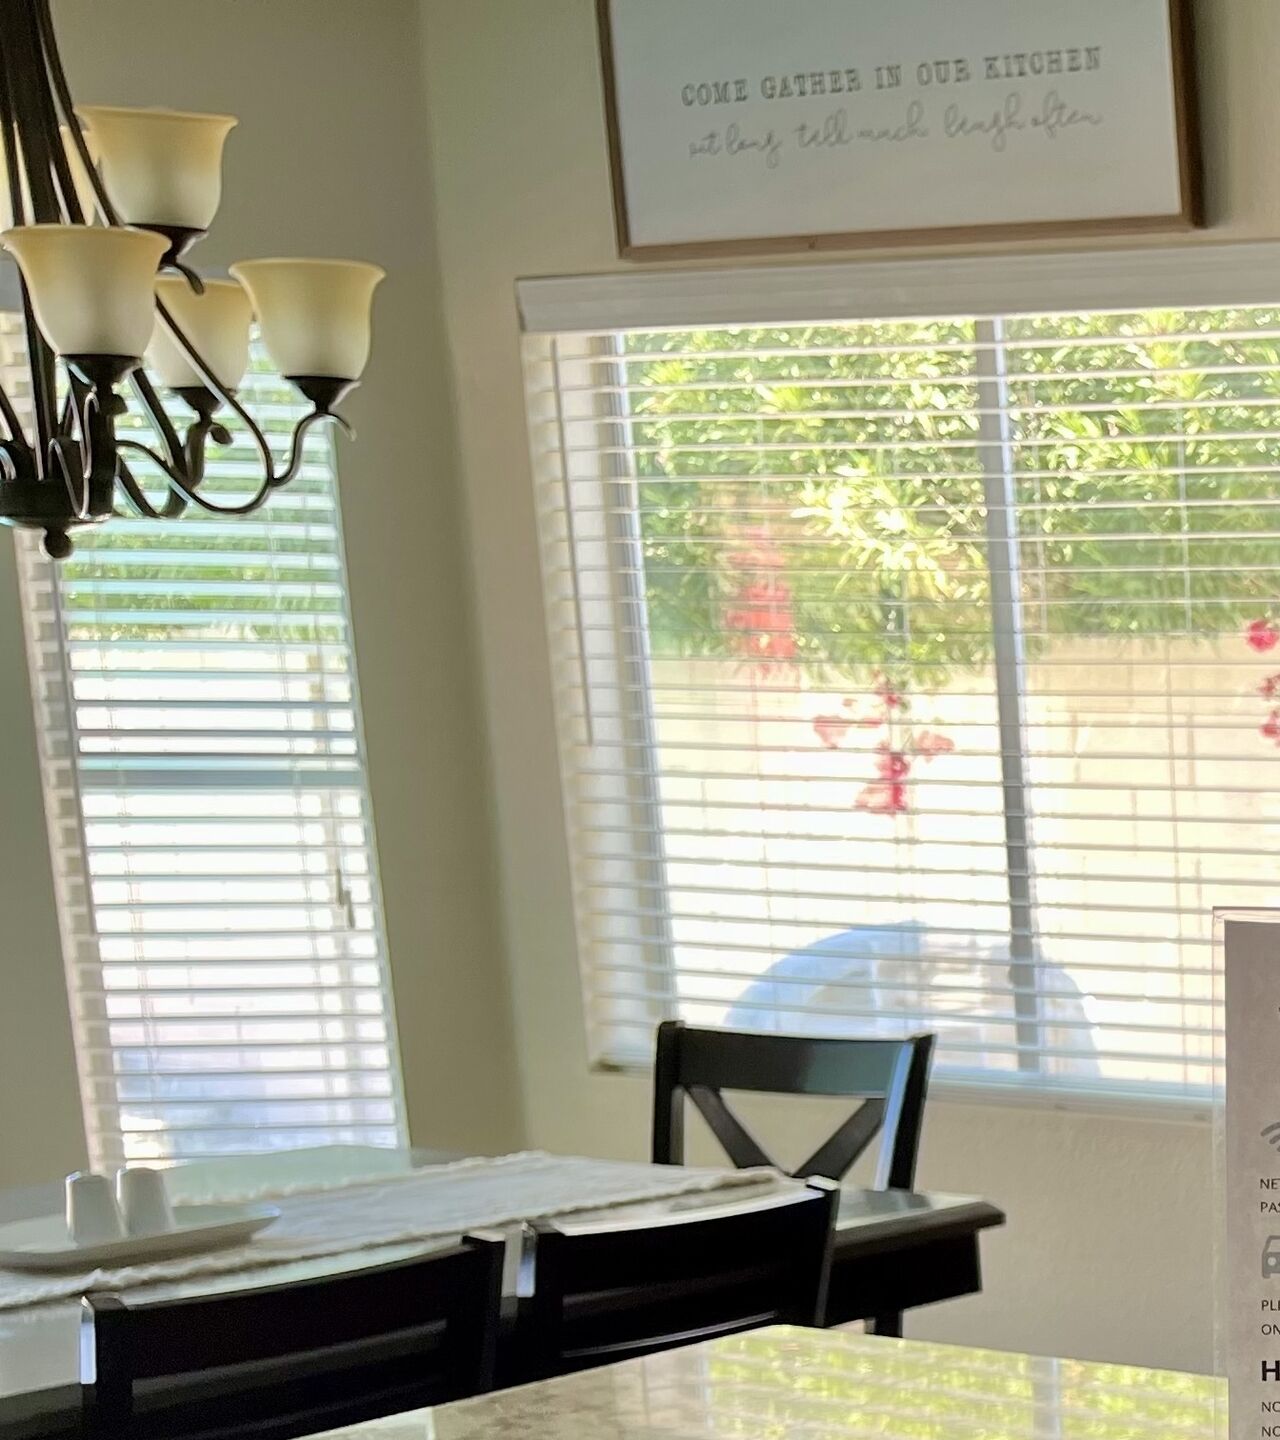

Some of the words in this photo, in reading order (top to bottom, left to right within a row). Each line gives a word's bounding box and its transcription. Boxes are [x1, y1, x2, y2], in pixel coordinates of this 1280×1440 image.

[681, 78, 748, 106] COME
[761, 68, 861, 99] GATHER
[875, 64, 901, 90] IN
[916, 59, 970, 86] OUR
[983, 47, 1100, 80] KITCHEN
